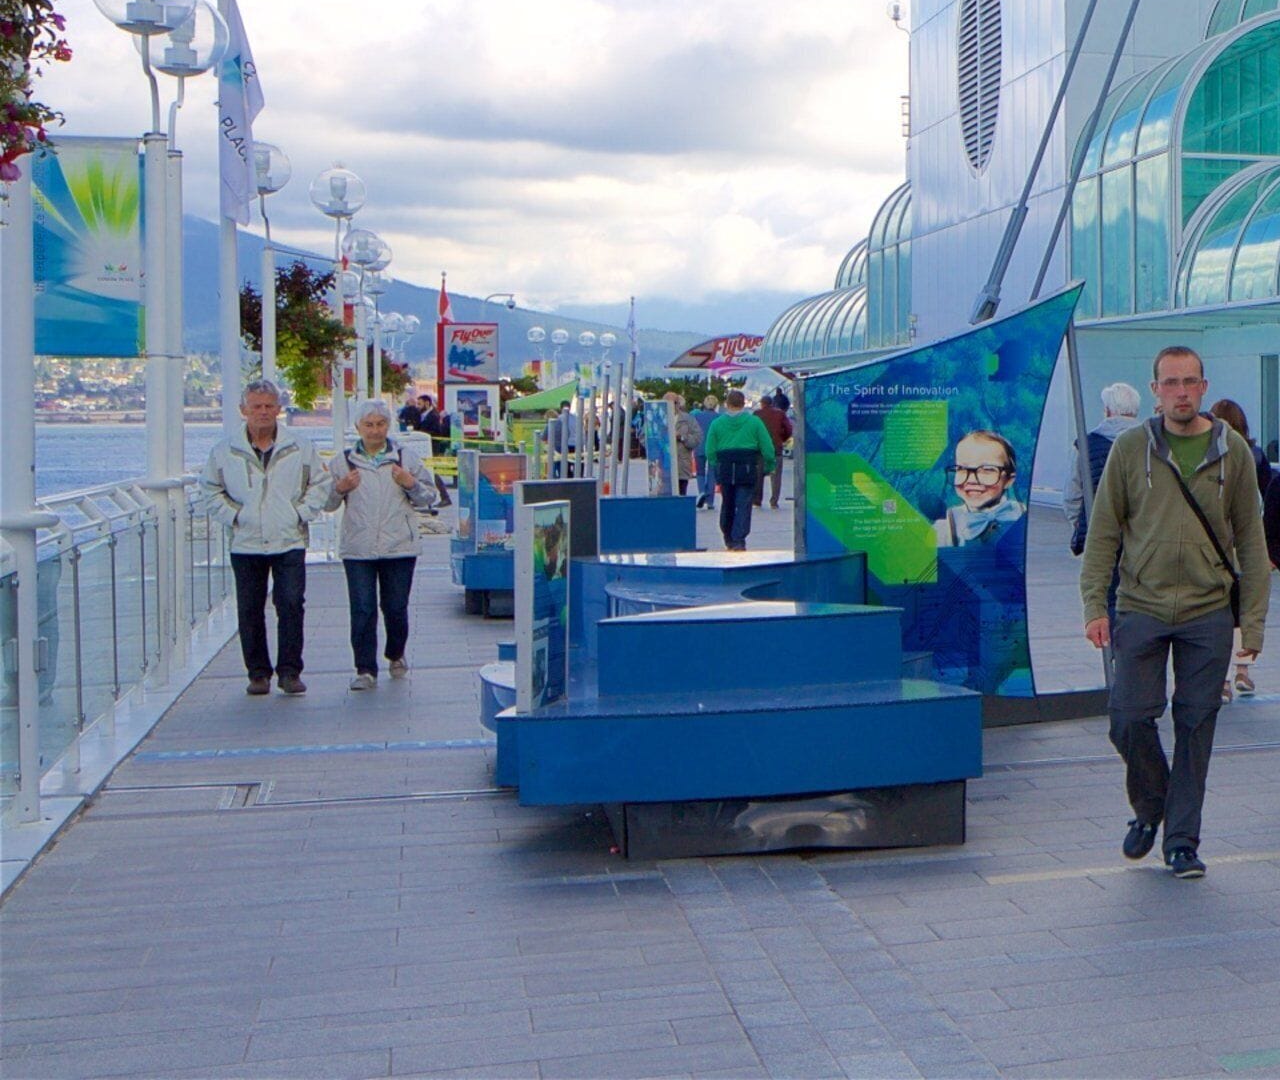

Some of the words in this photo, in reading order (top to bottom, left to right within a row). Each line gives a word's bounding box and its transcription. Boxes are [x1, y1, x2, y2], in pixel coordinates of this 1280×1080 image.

[220, 117, 247, 164] PLAC
[829, 383, 850, 395] The
[854, 384, 884, 398] Spirit
[887, 384, 899, 395] of
[902, 384, 960, 395] Innovation
